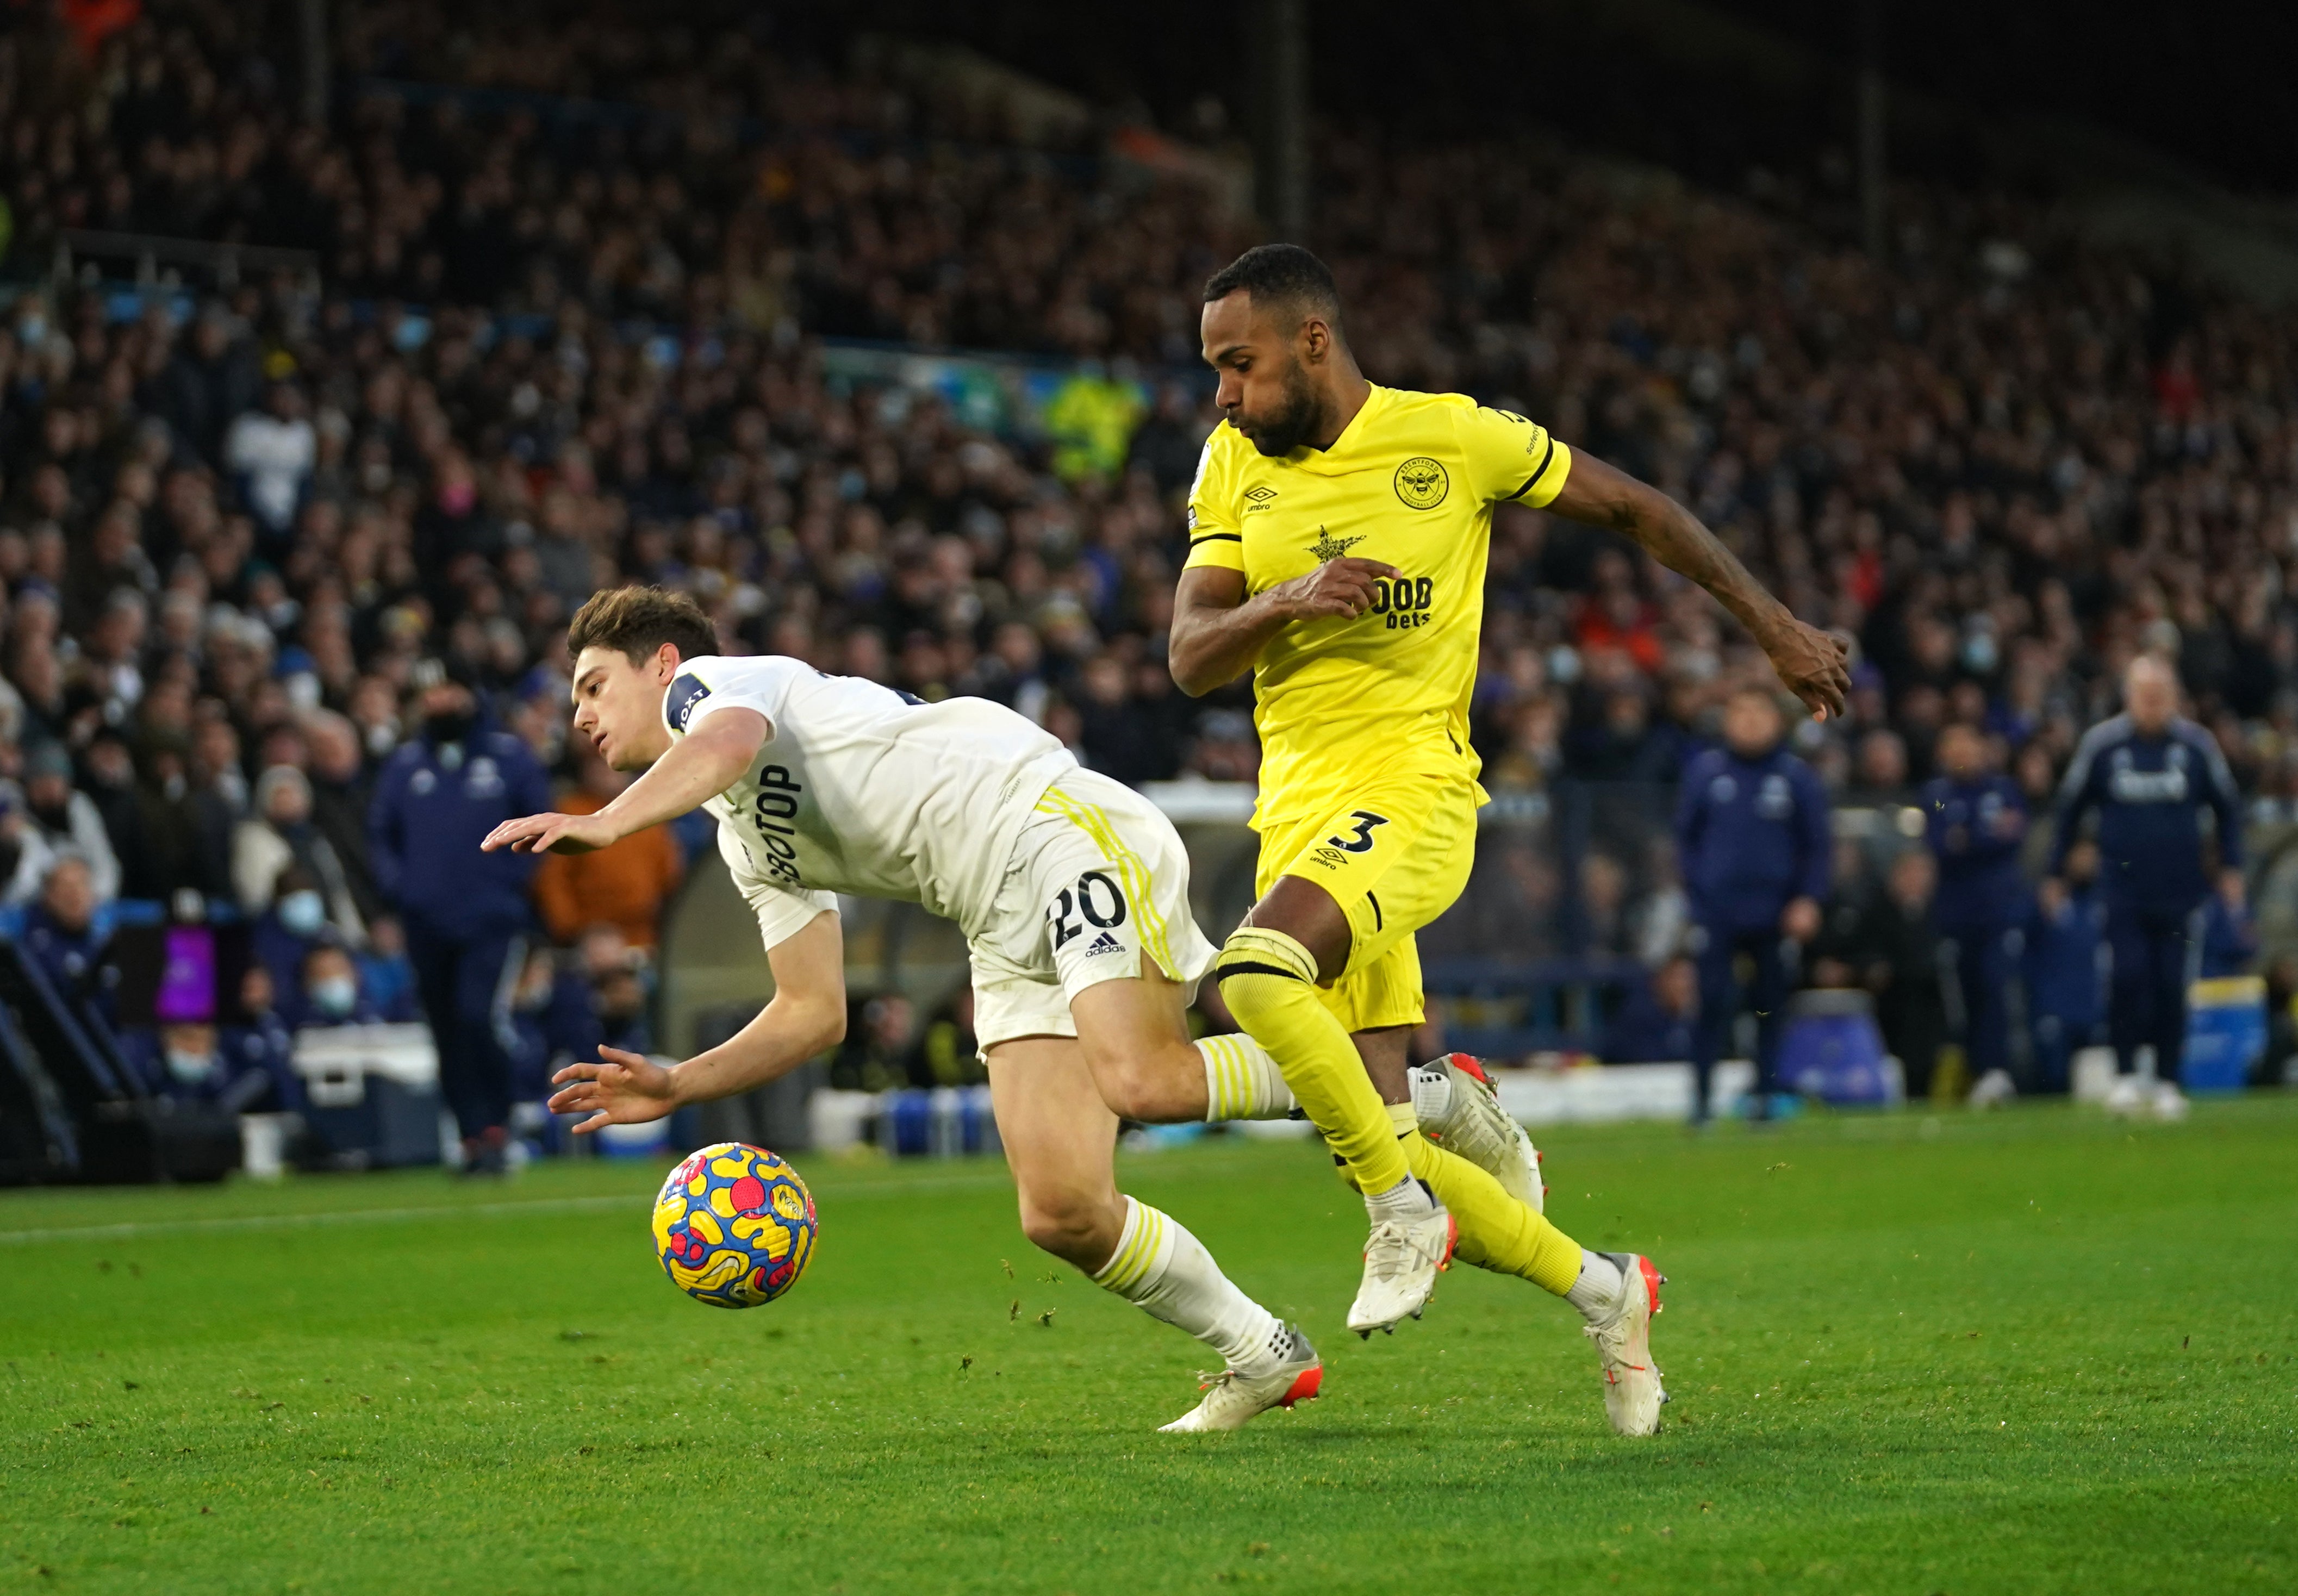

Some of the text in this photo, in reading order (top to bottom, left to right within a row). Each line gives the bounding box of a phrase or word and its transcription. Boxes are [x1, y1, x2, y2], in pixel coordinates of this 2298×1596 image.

[1400, 459, 1438, 474] BRENTFORD
[1248, 503, 1271, 512] umbro
[1404, 493, 1442, 507] FOOTBALL CLUB
[1371, 577, 1433, 614] OOD
[1386, 611, 1430, 629] bets
[1327, 809, 1390, 853] 3
[1309, 856, 1337, 870] umbro
[1045, 871, 1126, 953] 20
[1085, 944, 1126, 957] adidas
